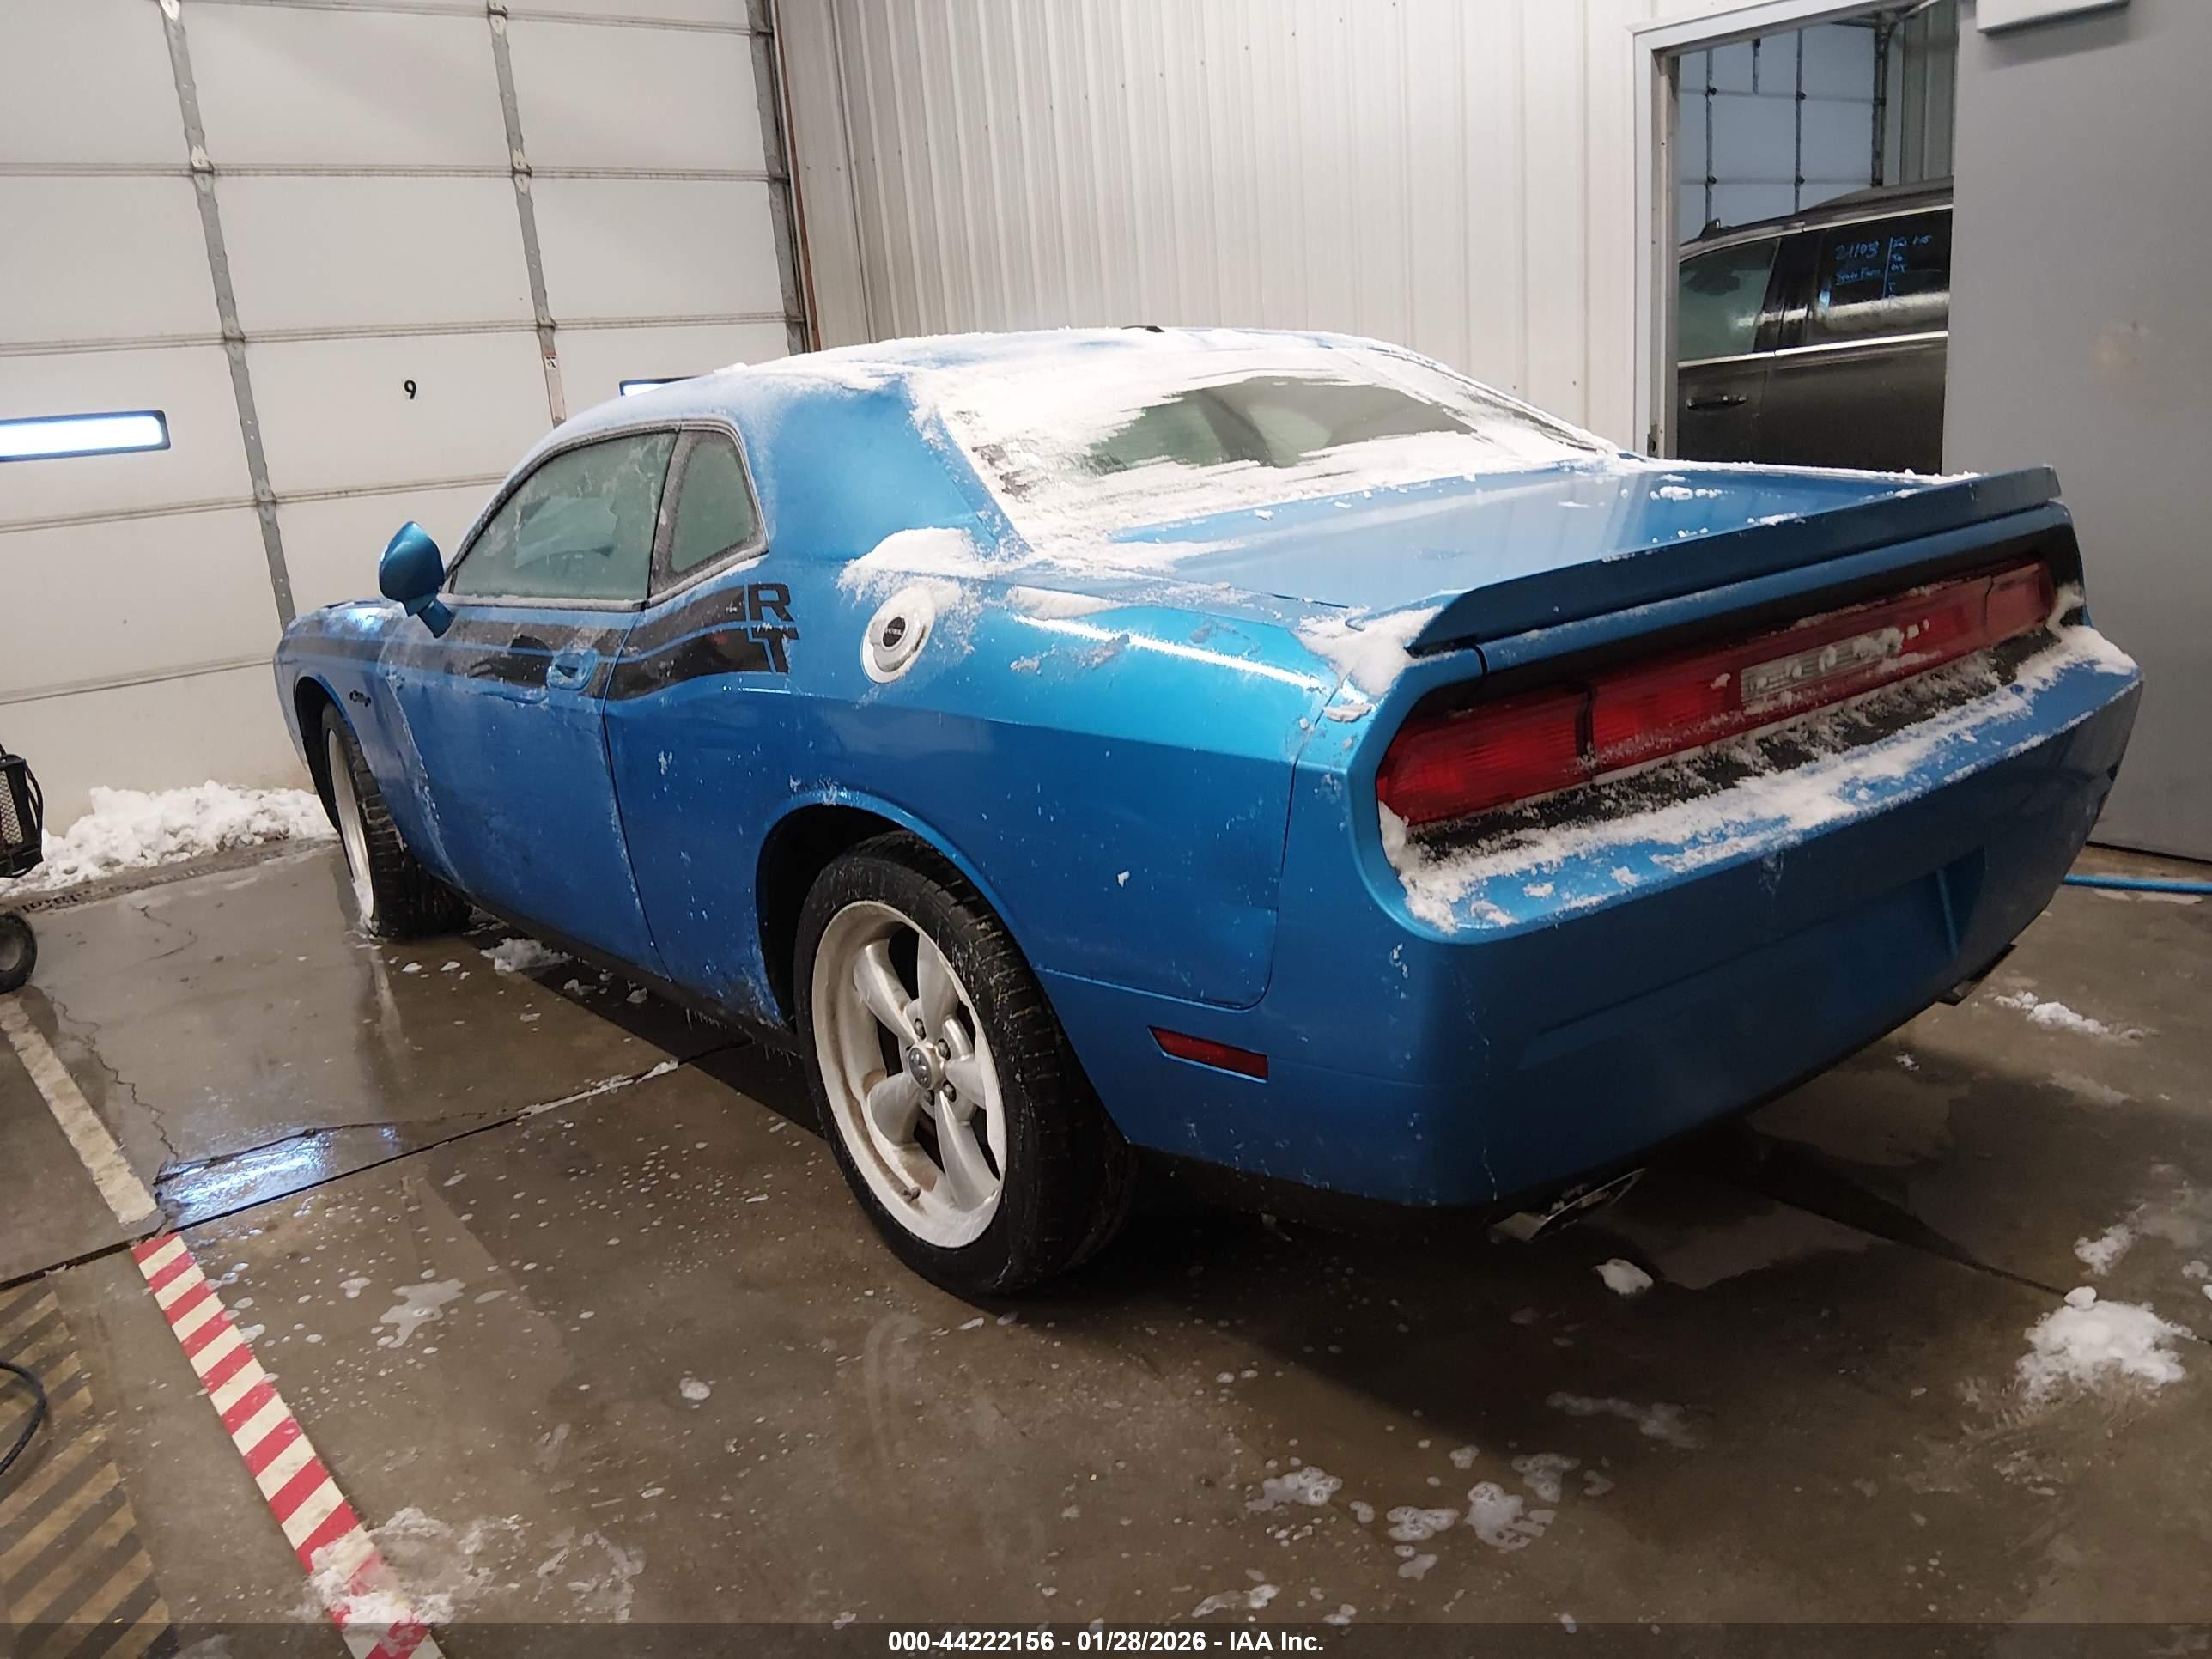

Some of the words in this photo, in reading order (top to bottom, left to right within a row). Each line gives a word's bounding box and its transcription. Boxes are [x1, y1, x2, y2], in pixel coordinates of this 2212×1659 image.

[404, 380, 416, 399] 9
[748, 583, 795, 622] R
[751, 627, 800, 674] T
